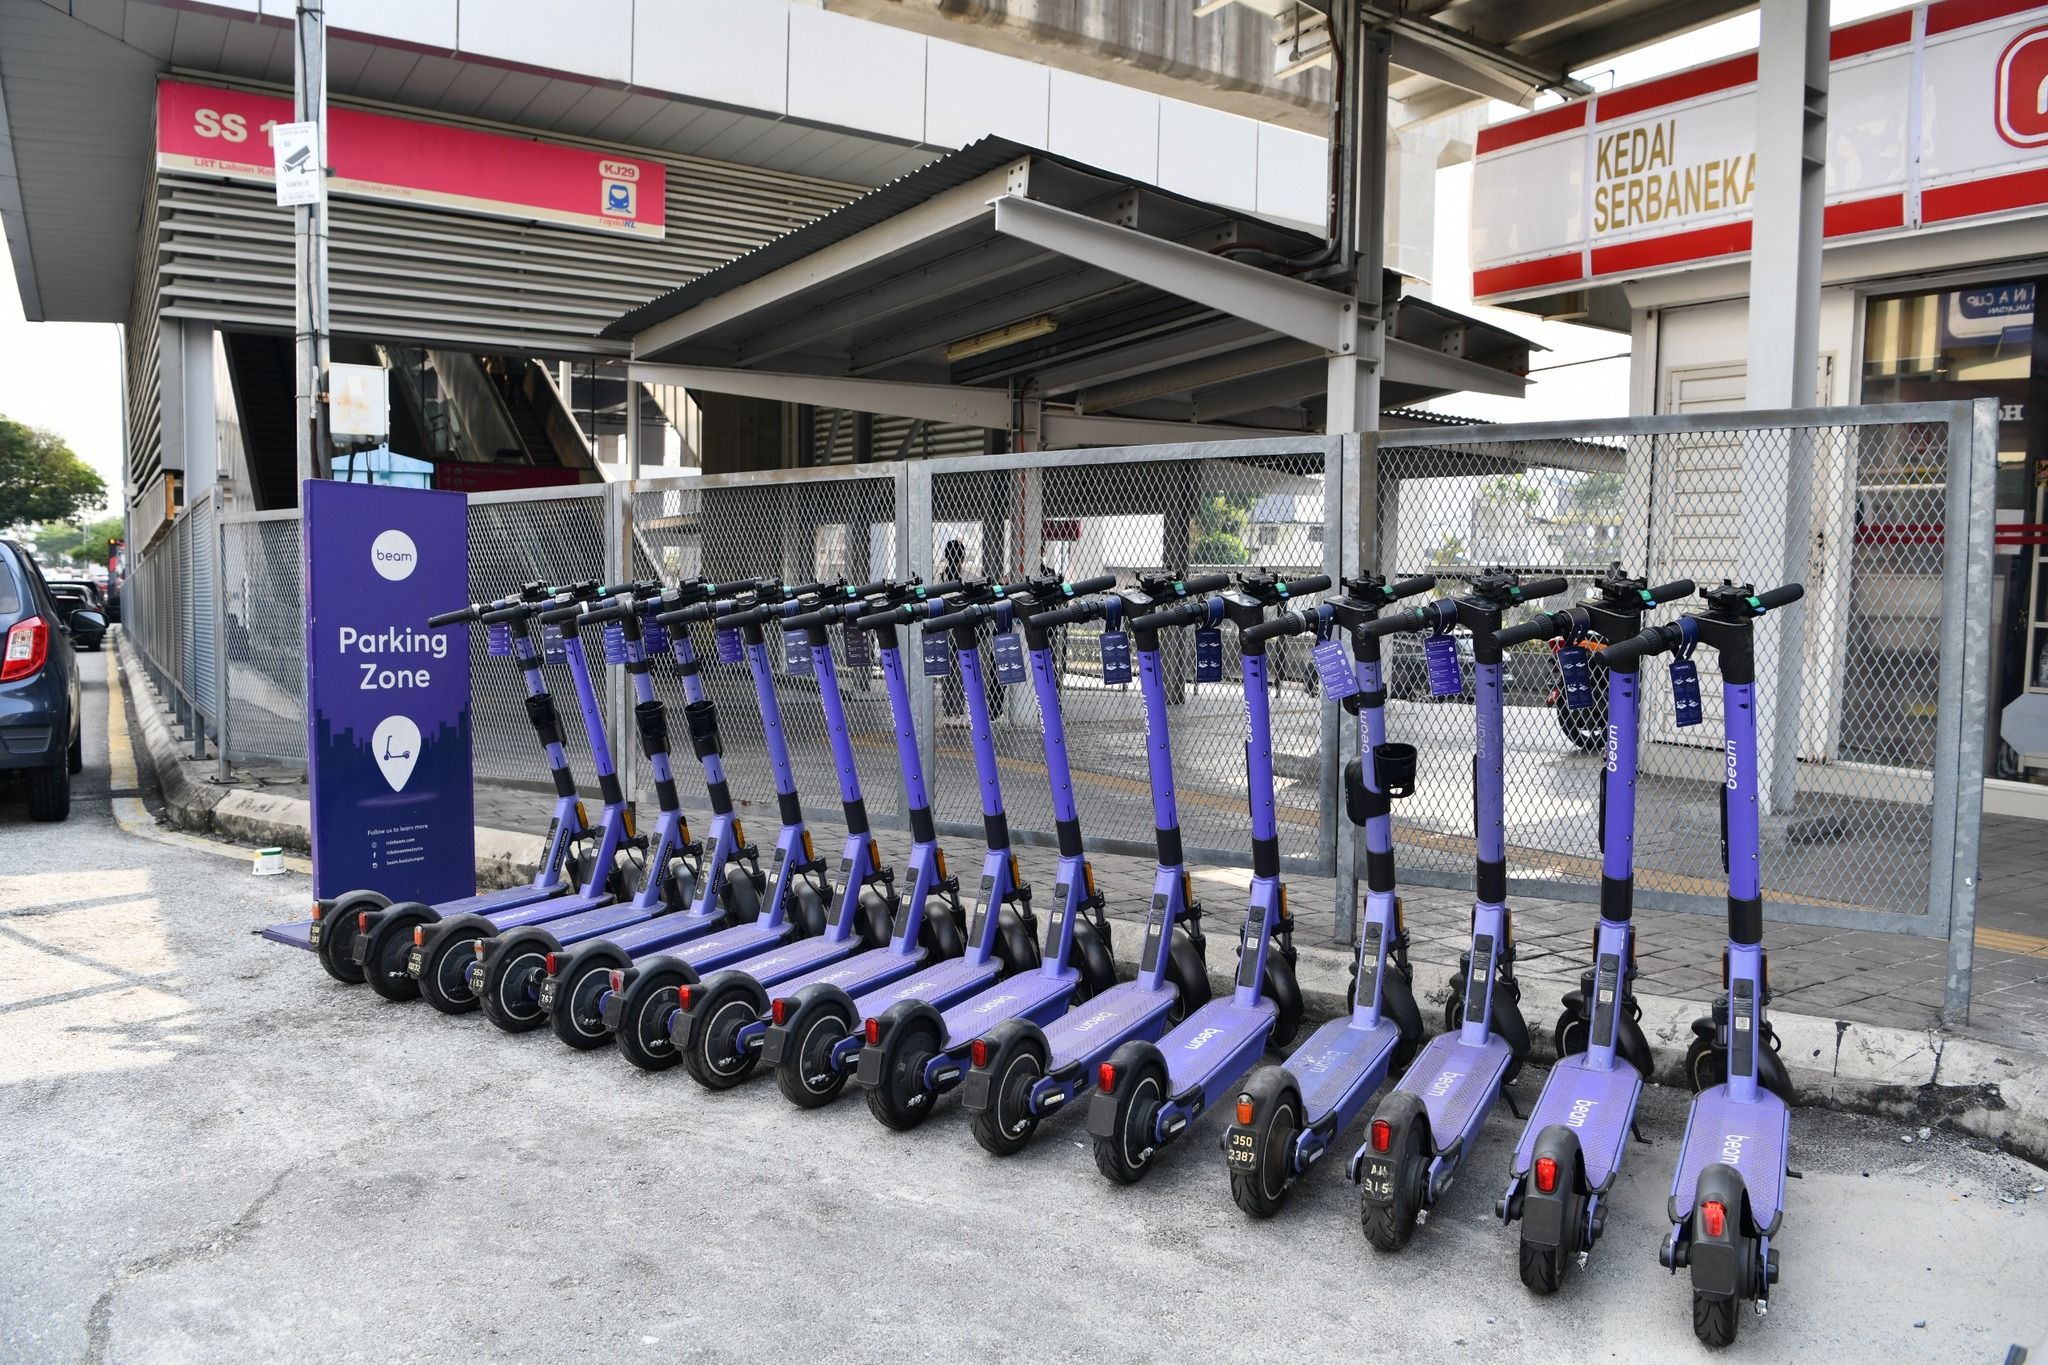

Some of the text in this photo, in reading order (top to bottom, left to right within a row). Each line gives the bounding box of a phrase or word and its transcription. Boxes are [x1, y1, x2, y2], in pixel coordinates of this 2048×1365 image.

[193, 108, 248, 143] SS
[194, 158, 215, 169] LRT
[1596, 119, 1675, 182] KEDAI
[604, 163, 635, 178] KJ29
[1594, 152, 1756, 232] SERBANEKA
[376, 549, 412, 562] beam
[339, 626, 447, 659] Parking
[360, 663, 430, 690] Zone
[1360, 710, 1370, 753] beam
[1477, 714, 1486, 759] beam
[1607, 724, 1618, 772] beam
[1726, 739, 1737, 790] beam
[975, 995, 1017, 1013] beam
[1075, 1011, 1118, 1031] beam
[1184, 1028, 1225, 1050] beam
[1428, 1071, 1465, 1097] beam
[1566, 1099, 1599, 1128] beam
[1233, 1134, 1253, 1147] 350
[1720, 1134, 1751, 1165] beam
[1228, 1150, 1256, 1163] 2387
